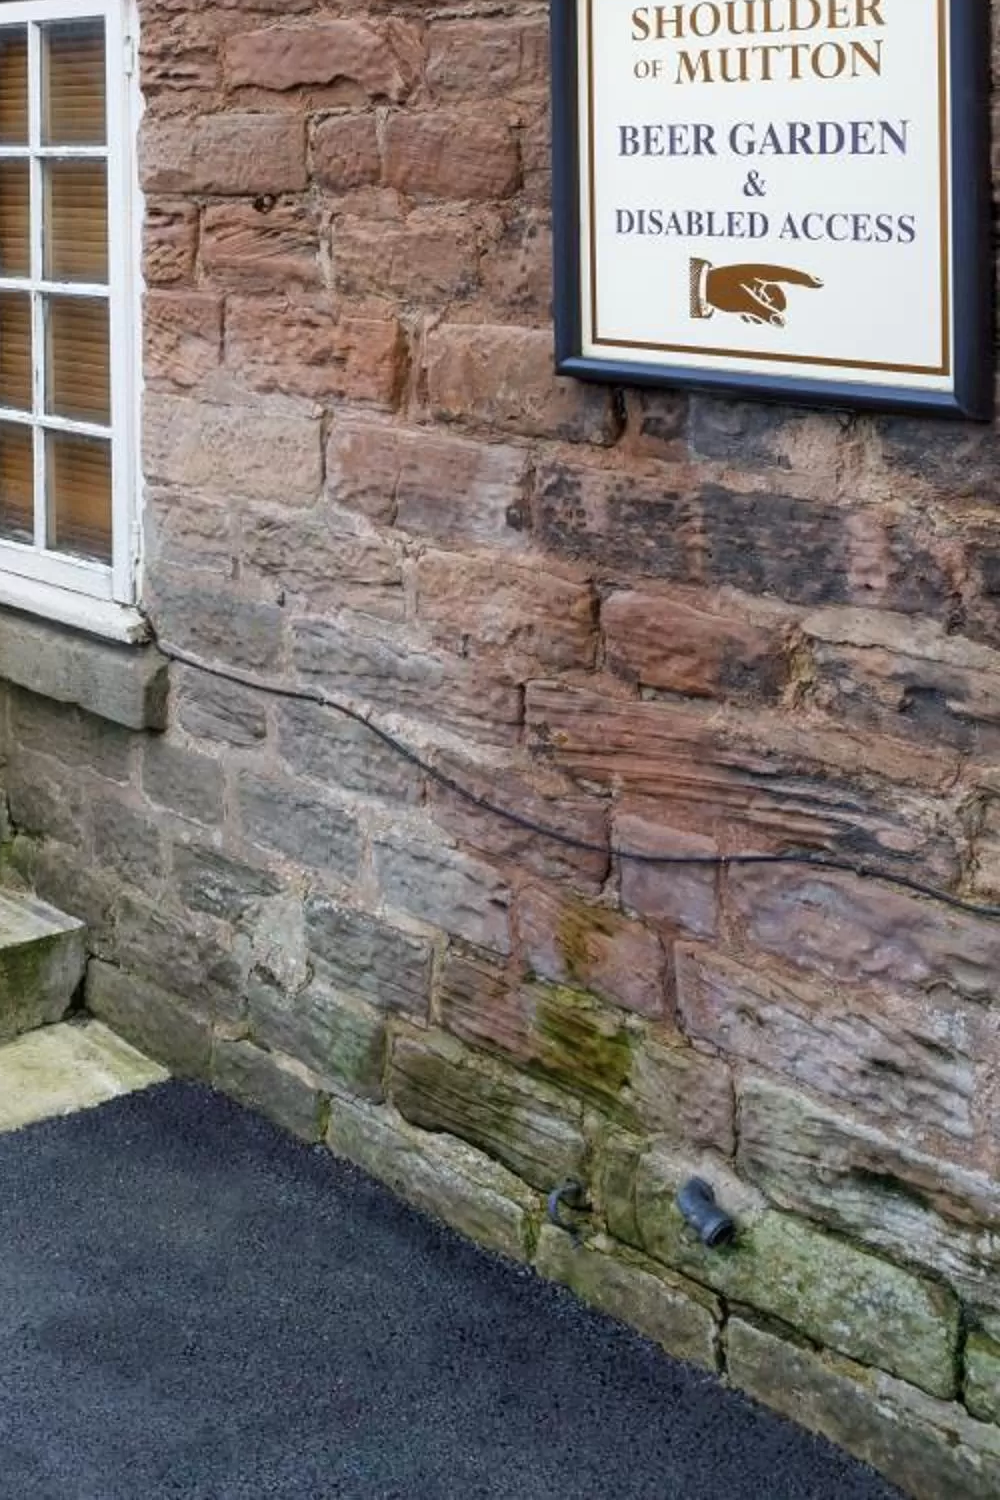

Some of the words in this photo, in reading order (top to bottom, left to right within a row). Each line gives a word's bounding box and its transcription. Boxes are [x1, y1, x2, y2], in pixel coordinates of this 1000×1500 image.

[633, 58, 663, 79] OF
[675, 39, 884, 85] MUTTON
[618, 123, 716, 157] BEER
[729, 119, 910, 156] GARDEN
[742, 170, 766, 197] &
[615, 209, 769, 238] DISABLED
[778, 213, 916, 243] ACCESS
